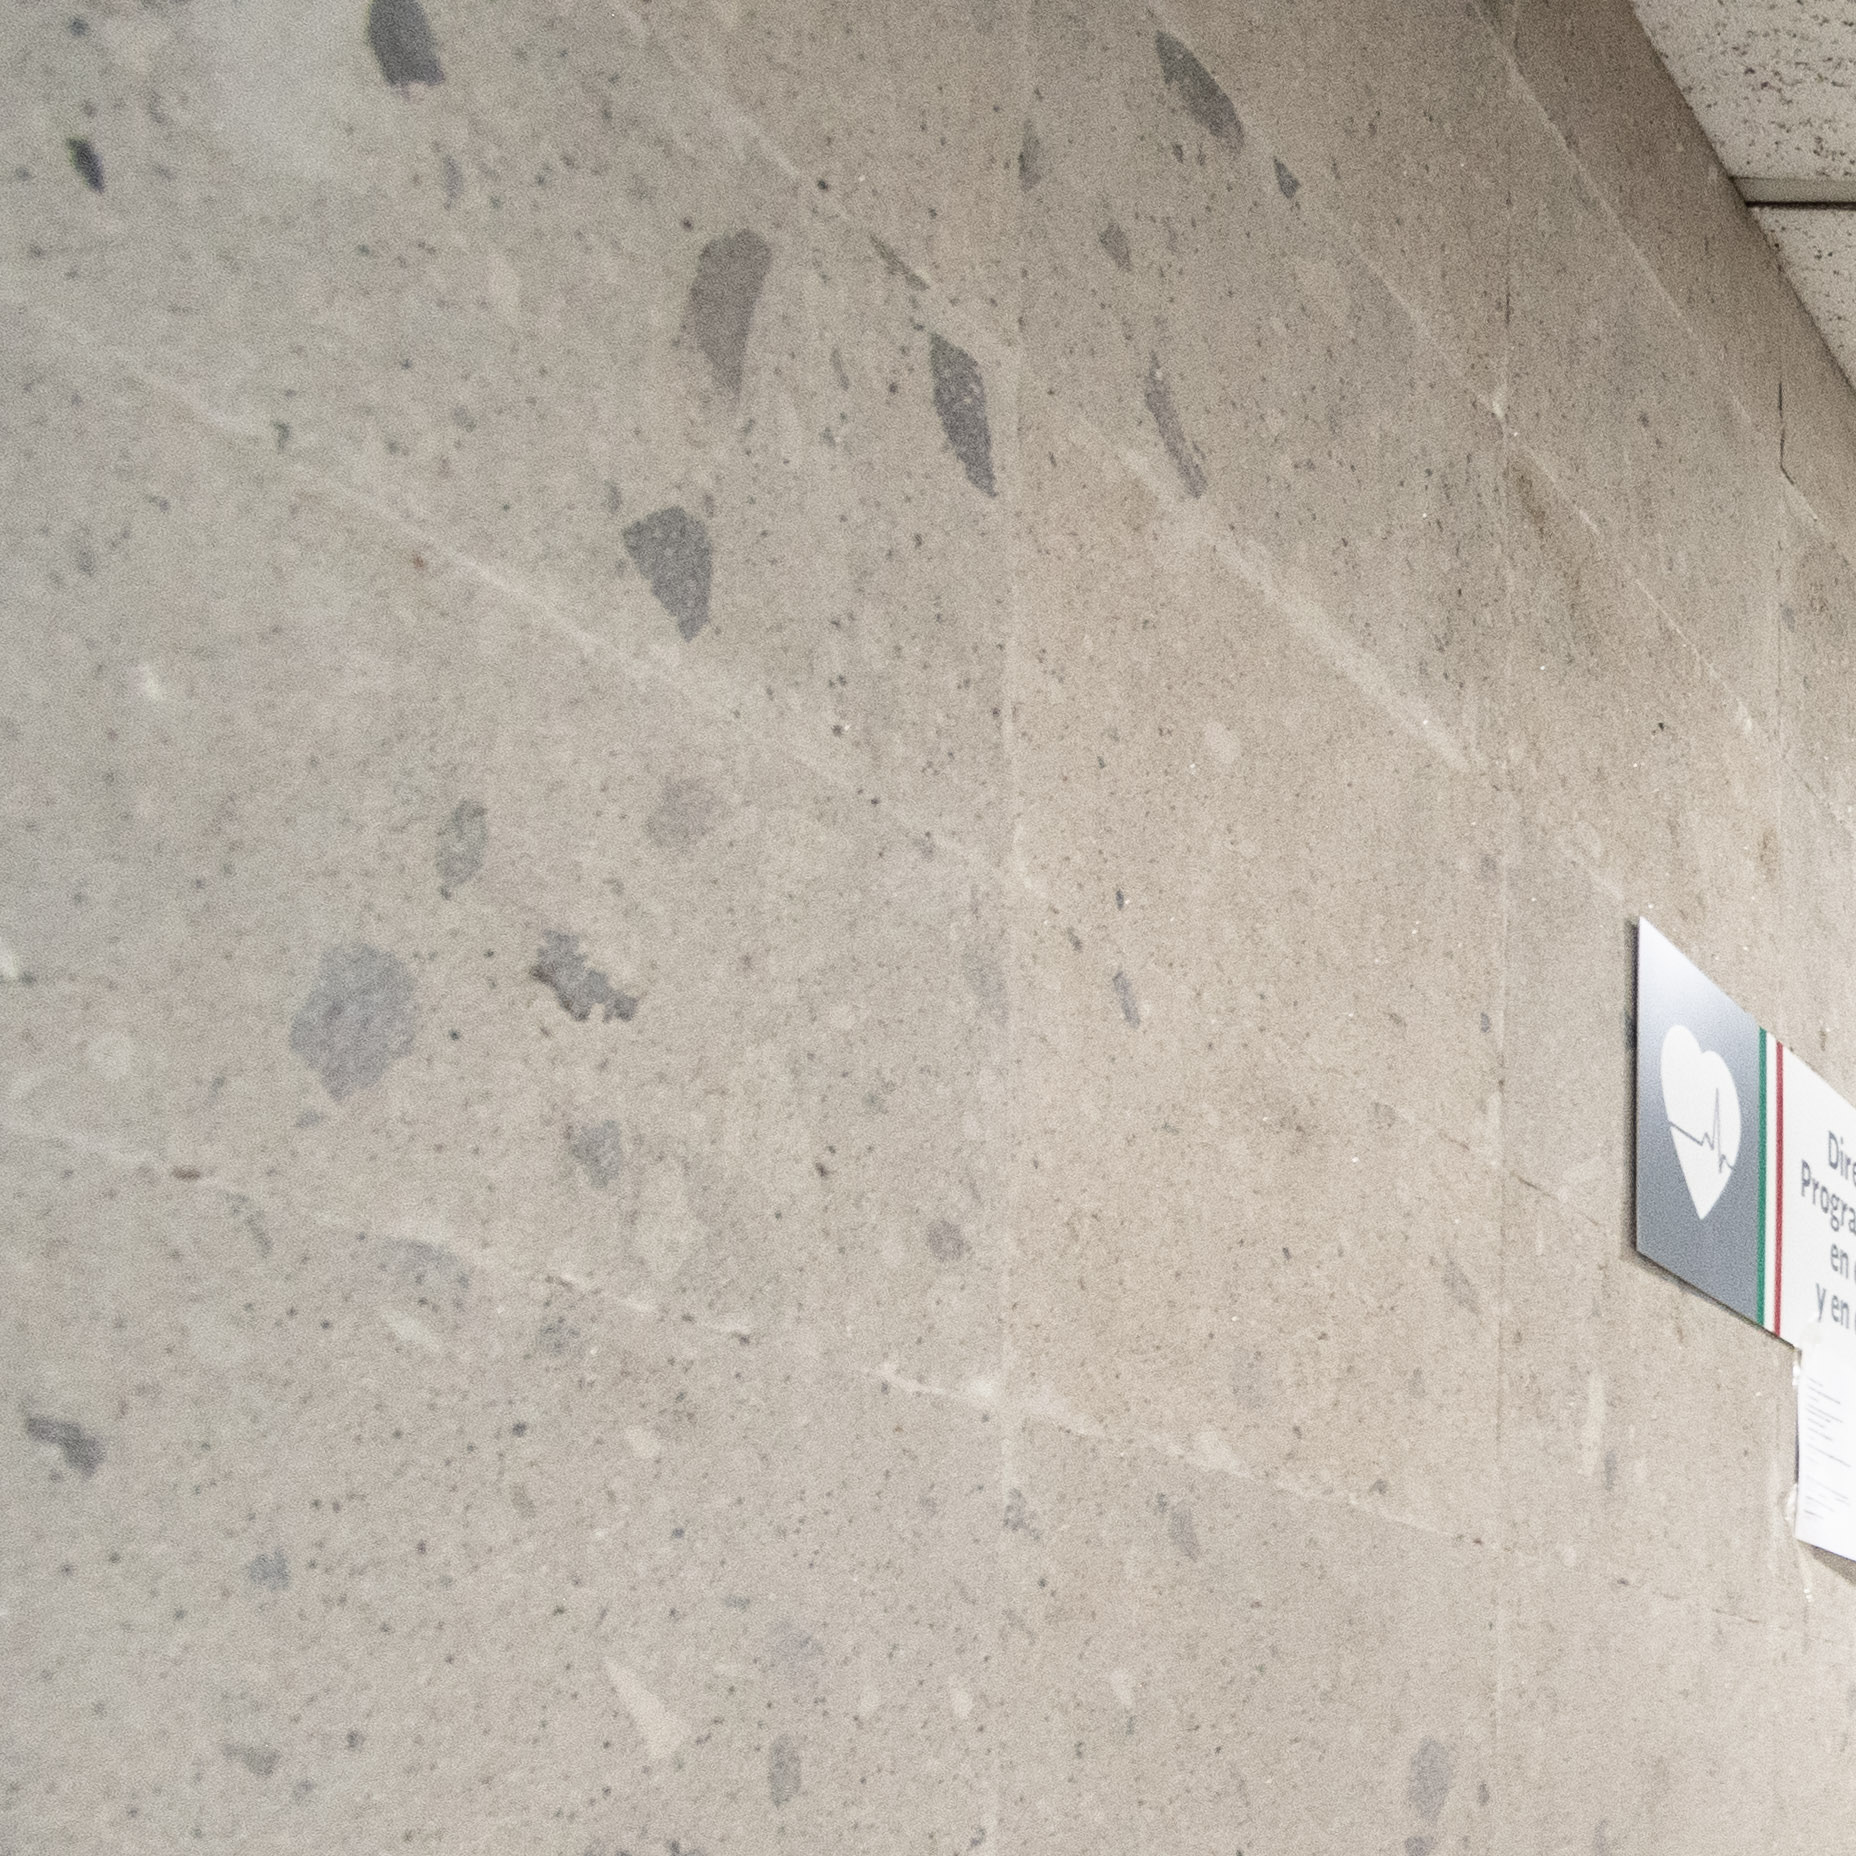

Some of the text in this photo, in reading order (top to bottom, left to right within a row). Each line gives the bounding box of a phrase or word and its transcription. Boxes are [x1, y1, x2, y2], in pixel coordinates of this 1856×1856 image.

[1830, 1243, 1849, 1280] en
[1815, 1282, 1827, 1323] y
[1831, 1295, 1850, 1329] en
